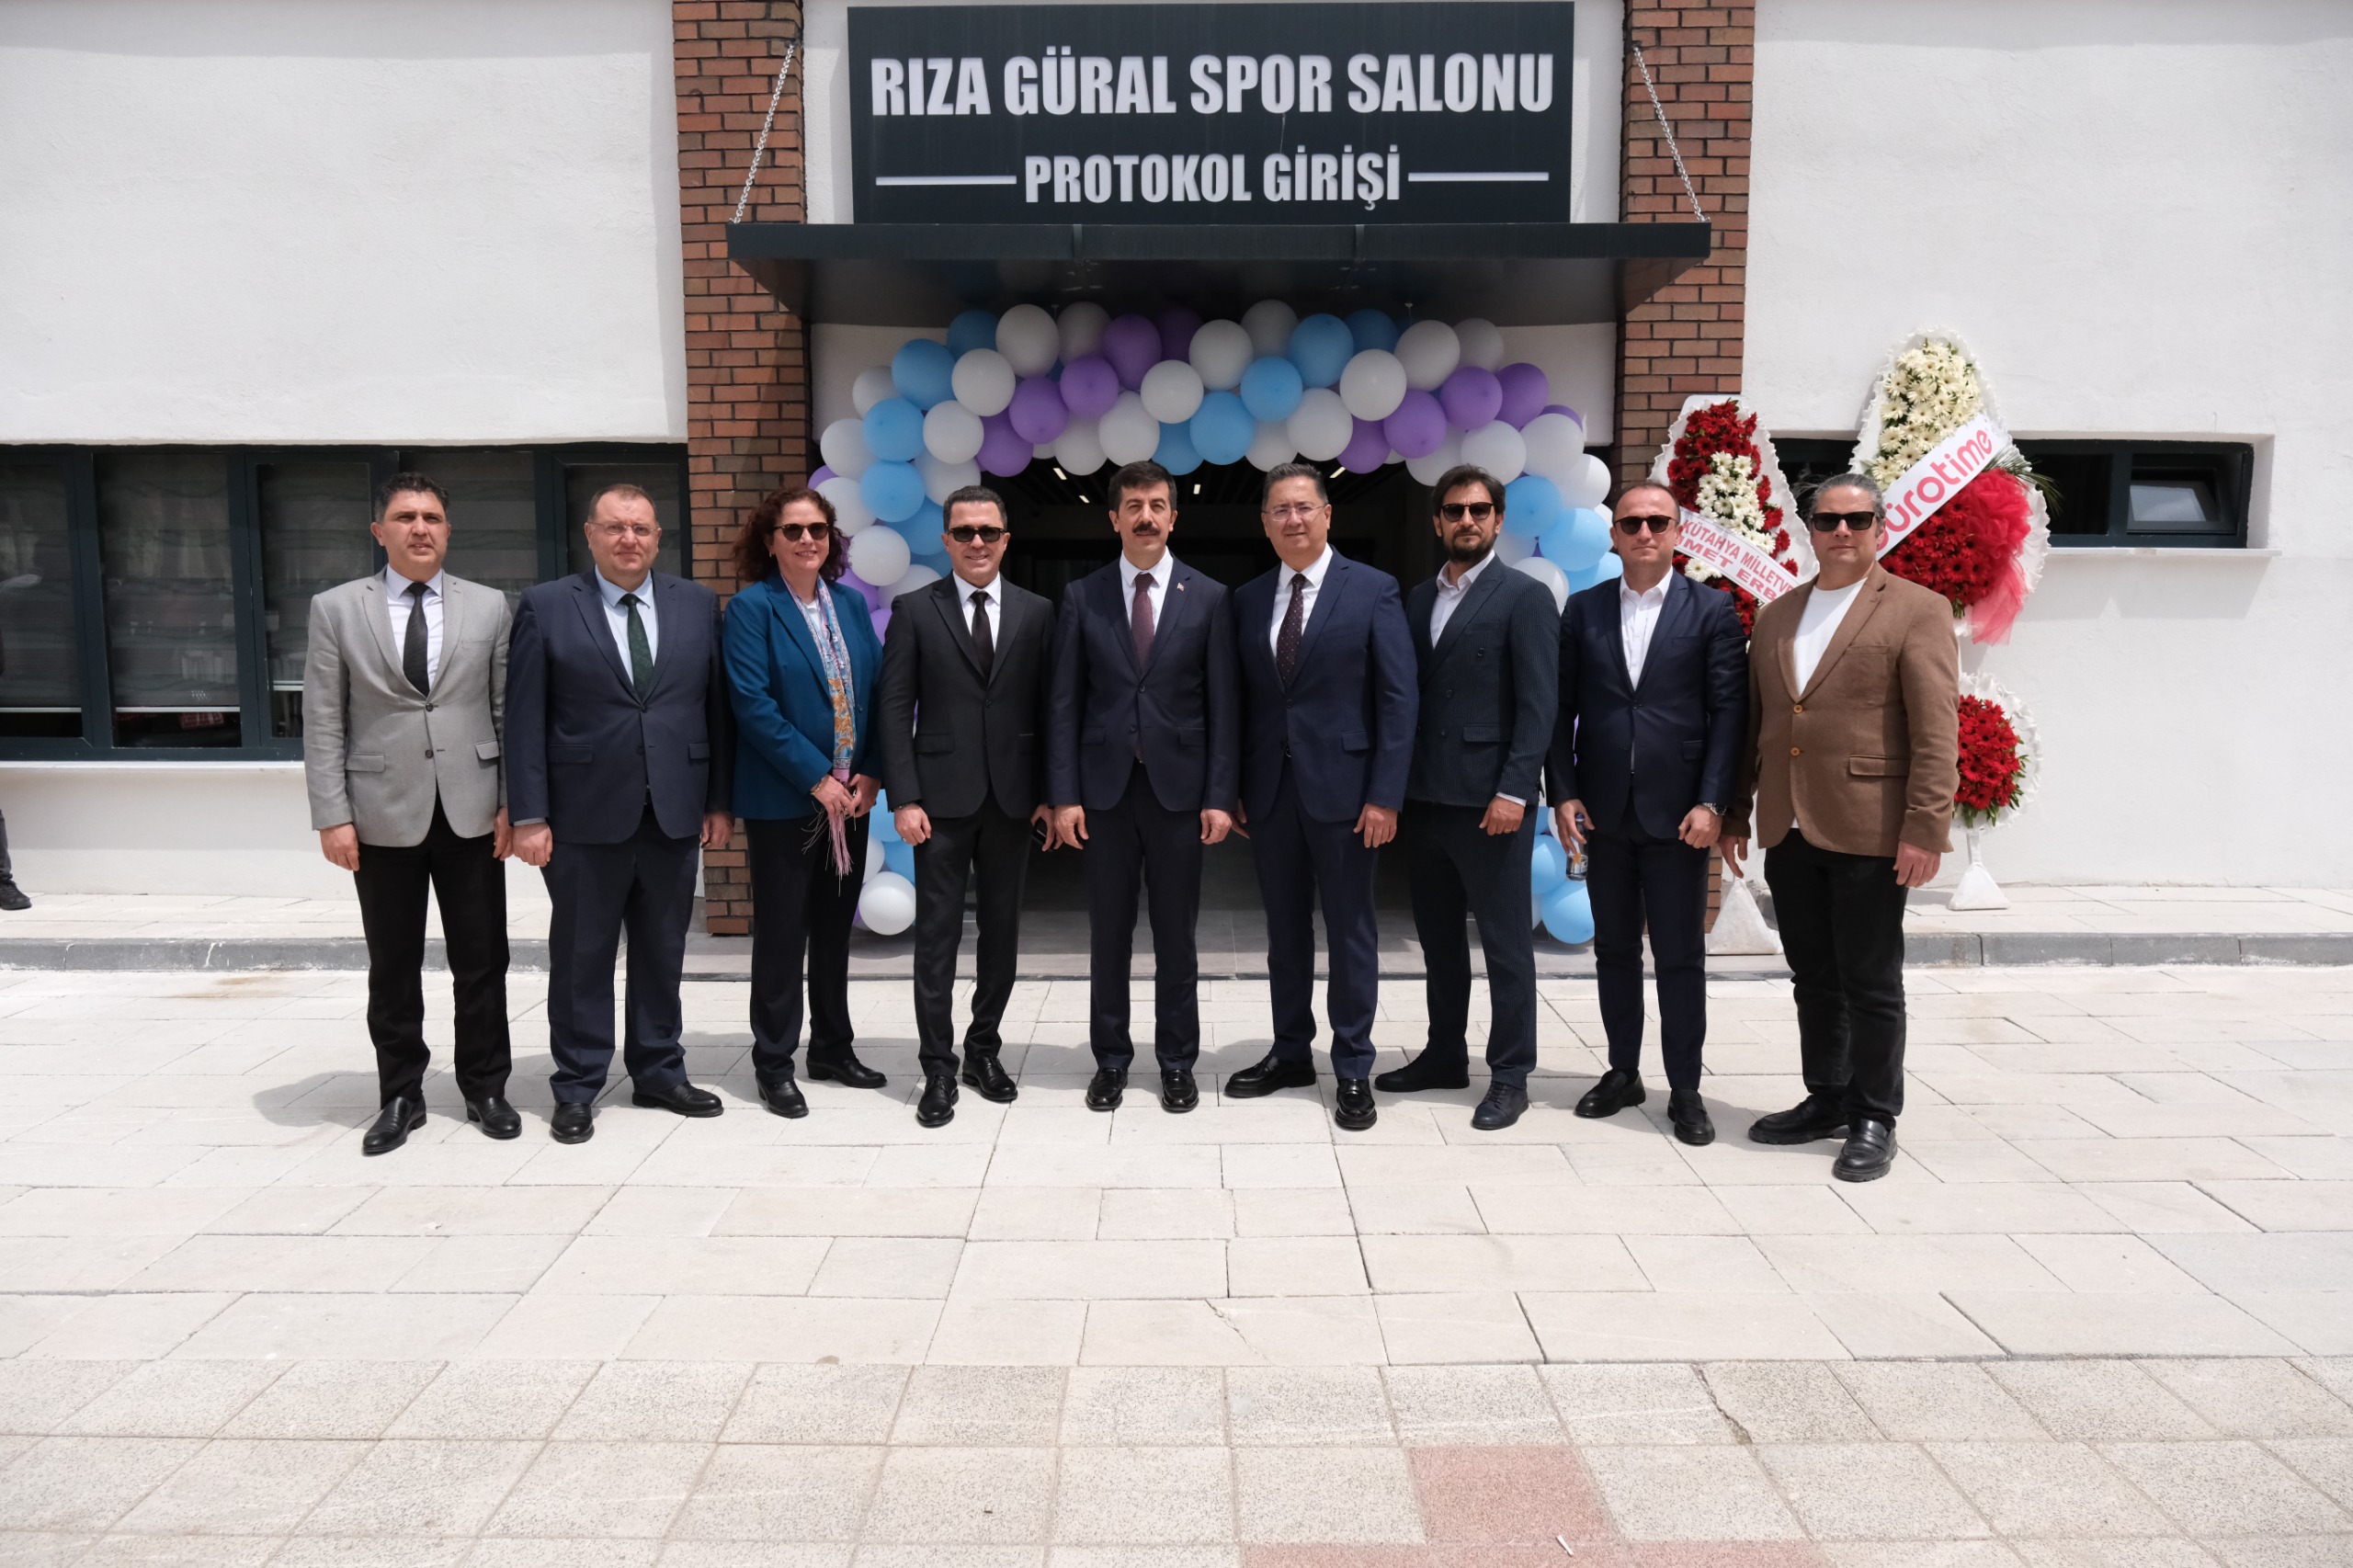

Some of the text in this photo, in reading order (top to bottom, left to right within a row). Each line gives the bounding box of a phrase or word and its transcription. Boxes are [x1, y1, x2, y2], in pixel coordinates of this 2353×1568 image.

[870, 45, 1553, 116] RIZA GÜRAL SPOR SALONU
[1025, 144, 1400, 210] PROTOKOL GİRİŞİ
[1877, 428, 1993, 551] ürotime
[1682, 519, 1741, 560] KÜTAHYA
